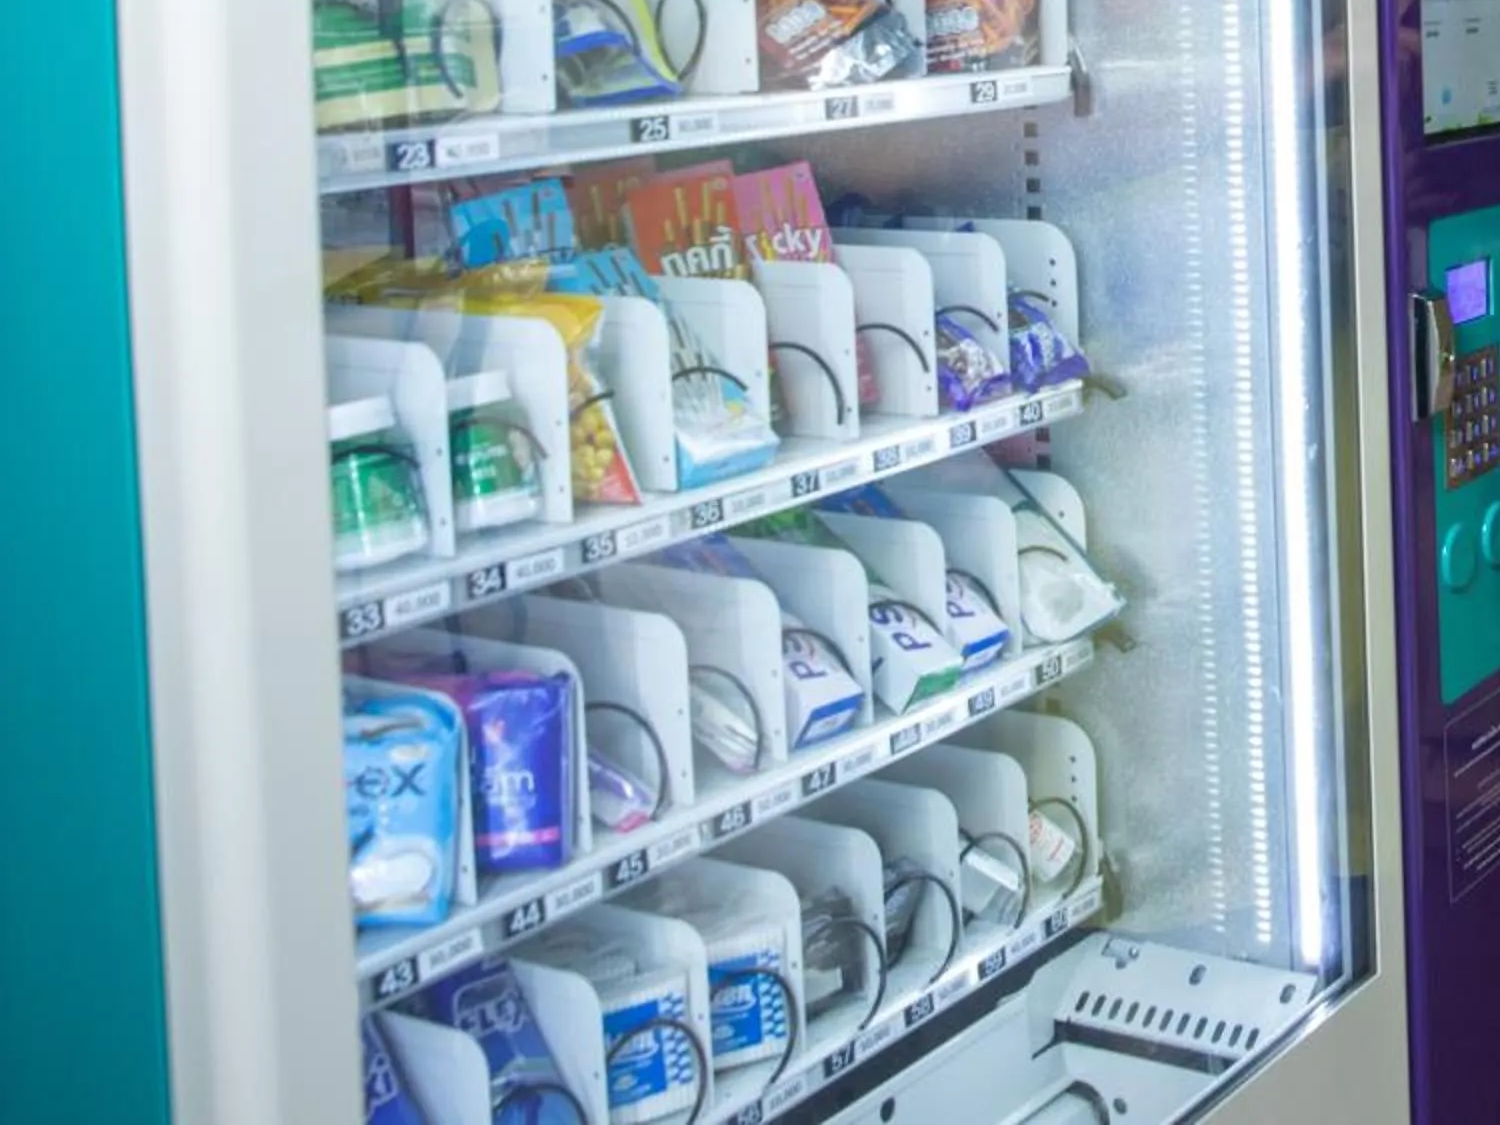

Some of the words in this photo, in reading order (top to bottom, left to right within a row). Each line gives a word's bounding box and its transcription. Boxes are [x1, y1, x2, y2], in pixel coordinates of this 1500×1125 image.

[974, 81, 993, 103] 29
[831, 98, 851, 118] 27
[640, 118, 667, 142] 25
[397, 143, 430, 169] 23
[1022, 402, 1040, 421] 40
[693, 499, 720, 526] 36
[585, 531, 614, 561] 35
[469, 567, 503, 598] 34
[346, 602, 381, 637] 33
[810, 764, 833, 790] 47
[721, 806, 747, 831] 46
[617, 856, 645, 884] 45
[510, 906, 540, 933] 44
[379, 965, 414, 994] 43
